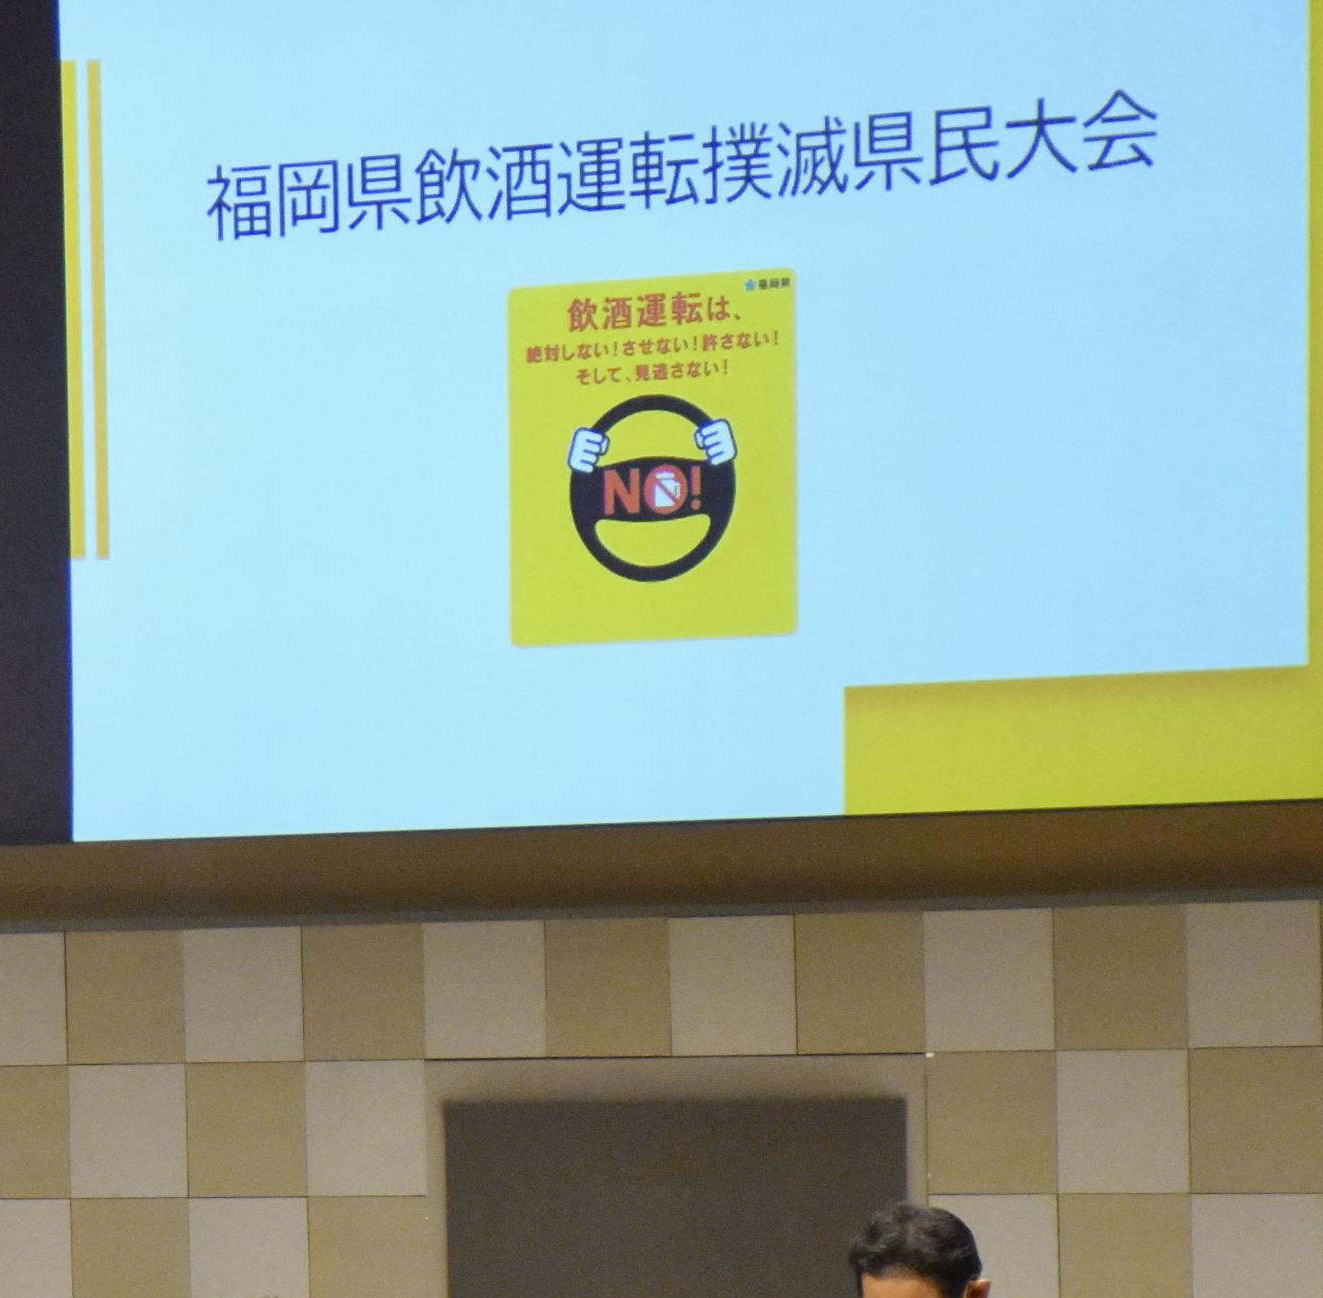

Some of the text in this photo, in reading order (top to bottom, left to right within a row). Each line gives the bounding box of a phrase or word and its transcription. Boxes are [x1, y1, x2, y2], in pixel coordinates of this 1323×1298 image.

[207, 88, 1158, 242] 福岡県飲酒運転撲滅県民大会
[566, 290, 744, 333] 飲酒運転は、
